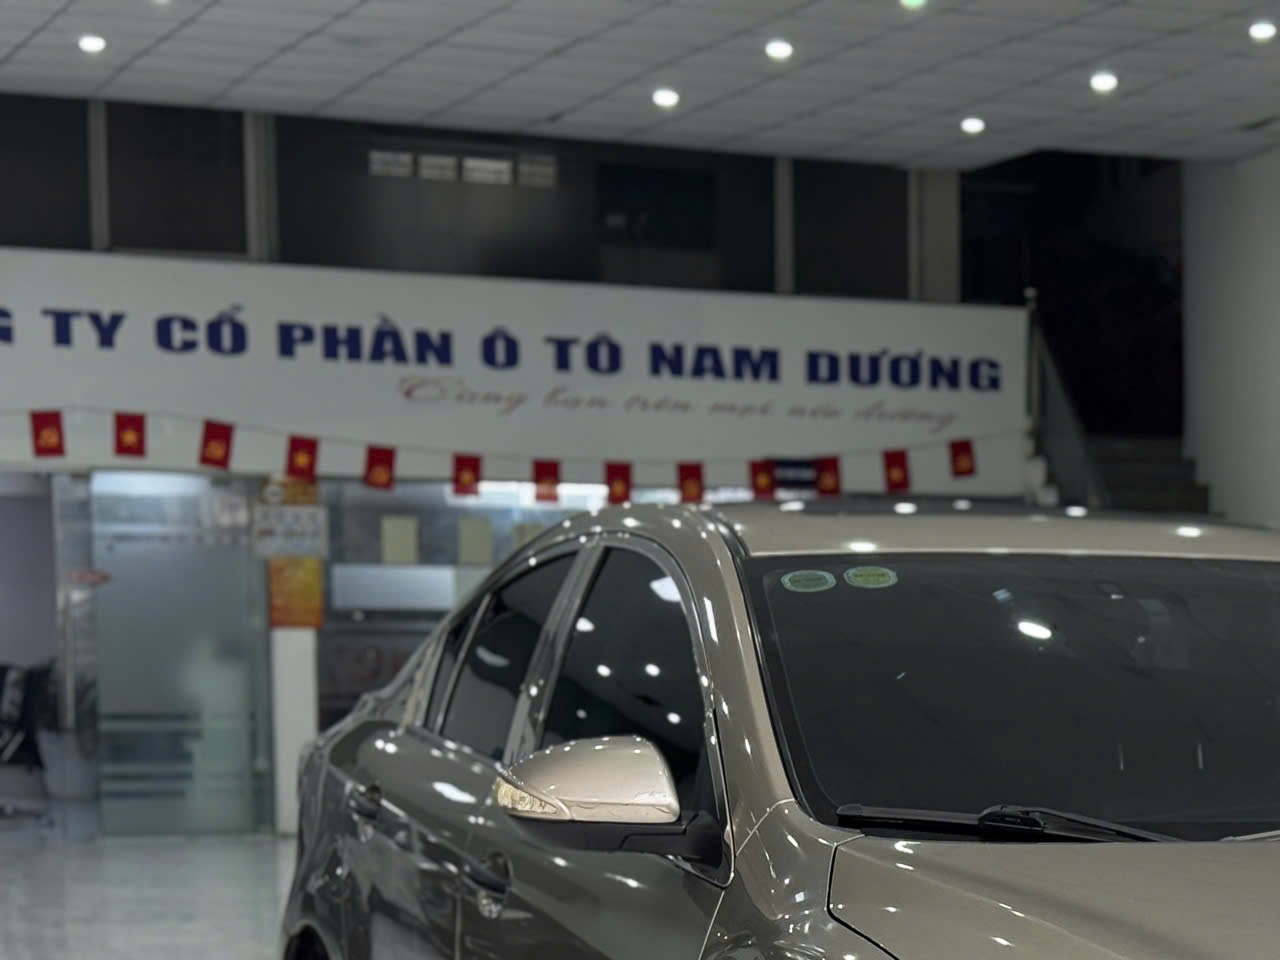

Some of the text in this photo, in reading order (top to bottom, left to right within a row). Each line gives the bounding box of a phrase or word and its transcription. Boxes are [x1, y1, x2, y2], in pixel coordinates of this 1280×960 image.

[42, 308, 126, 349] TY
[479, 326, 520, 371] Ô
[545, 332, 624, 376] TÔ
[647, 341, 782, 384] NAM
[804, 347, 1002, 393] DƯƠNG
